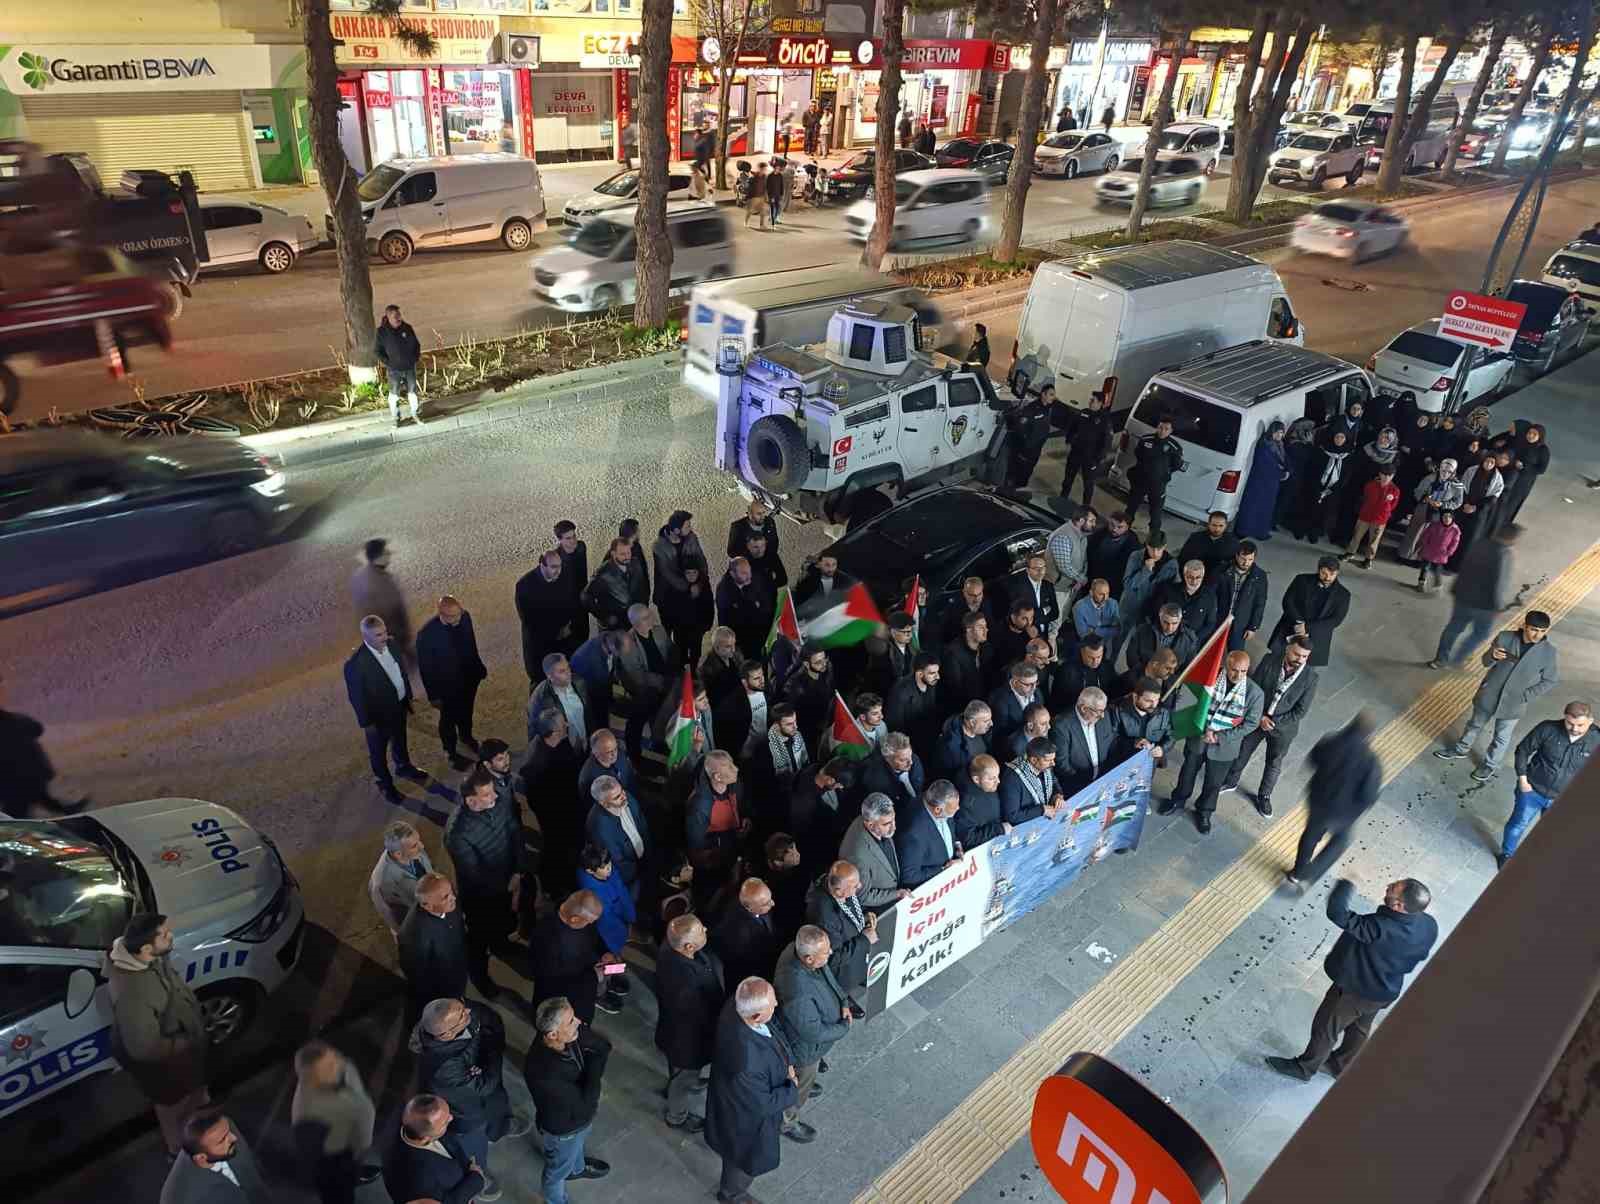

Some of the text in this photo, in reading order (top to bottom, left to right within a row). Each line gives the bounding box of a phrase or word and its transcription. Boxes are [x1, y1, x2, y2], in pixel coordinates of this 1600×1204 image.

[334, 15, 495, 39] ANKARA PRDE SHOWROOM
[583, 35, 641, 54] ECZA
[51, 57, 215, 82] Garanti BBVA
[608, 55, 634, 65] DEVA
[554, 91, 586, 101] DEVA
[909, 855, 978, 914] Sumud
[906, 906, 946, 940] İçin
[903, 912, 966, 964] Ayağa
[900, 942, 953, 988] Kalk!
[0, 1037, 99, 1101] OLİS
